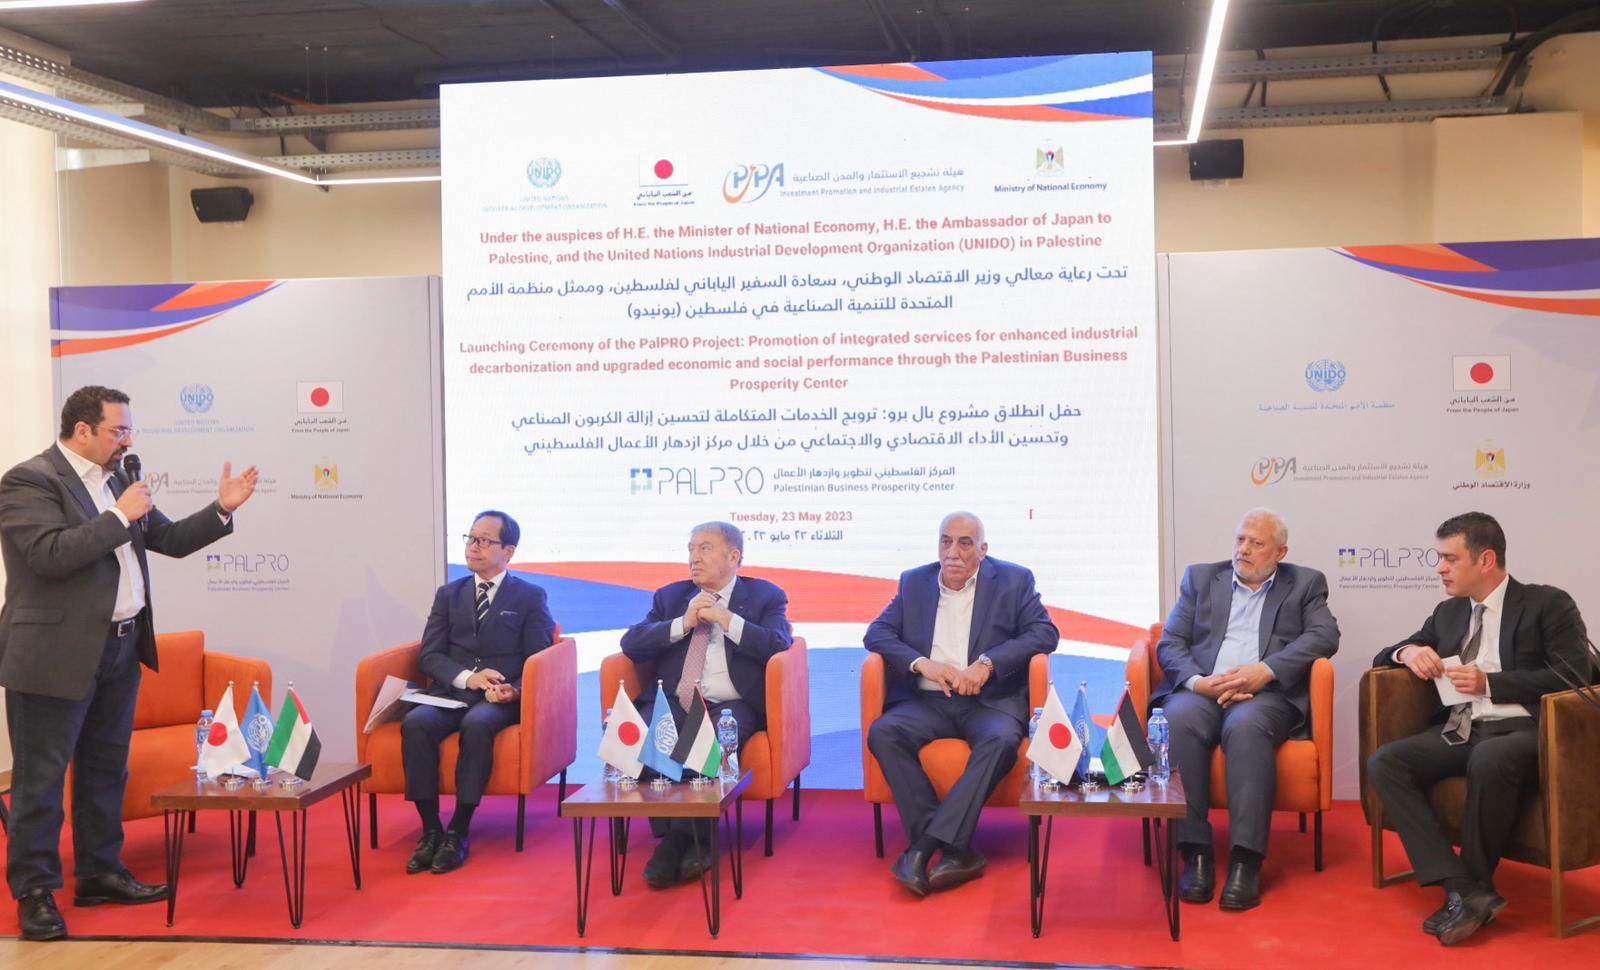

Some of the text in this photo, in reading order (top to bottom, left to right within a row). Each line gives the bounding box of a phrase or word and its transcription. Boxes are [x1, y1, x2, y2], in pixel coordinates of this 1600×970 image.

[993, 181, 1108, 195] Ministry of National Economy
[479, 212, 1112, 244] Under the auspices of H.E. the Minister of National Economy, H.E. the Ambassador of Japan to
[488, 234, 1103, 265] Palestine, and the United Nations Industrial Development Organization (UNIDO) in Palestine
[791, 273, 837, 288] سعادة
[906, 268, 970, 285] الاقتصاد
[974, 269, 1001, 286] وزير
[1004, 266, 1054, 288] معالي
[1055, 265, 1092, 284] رعاية
[1096, 265, 1129, 280] تحت
[466, 281, 504, 302] الأمم
[506, 281, 554, 296] منظمة
[556, 279, 605, 297] وممثل
[683, 275, 736, 297] الياباني
[740, 273, 787, 292] السفير
[684, 300, 748, 320] فلسطين
[751, 300, 780, 319] في
[783, 297, 843, 316] الصناعية
[847, 296, 897, 315] للتنمية
[900, 294, 954, 310] المتحدة
[459, 325, 1139, 355] Launching Ceremony of the PalPRO Project: Promotion of integrated services for enhanced industrial
[469, 349, 1128, 375] decarbonization and upgraded economic and social performance through the Palestinian Business
[1304, 368, 1347, 381] UNIDO
[729, 376, 849, 393] Prosperity Center
[180, 392, 215, 404] UNIDO
[511, 411, 571, 432] الصناعي
[574, 410, 623, 429] الكربون
[657, 408, 711, 427] لتحسين
[714, 407, 777, 423] المتكاملة
[780, 406, 838, 425] الخدمات
[841, 407, 878, 427] ترويج
[911, 405, 934, 424] بال
[938, 403, 990, 425] مشروع
[993, 403, 1045, 424] انطلاق
[1048, 403, 1083, 422] حفل
[523, 429, 1069, 457] وتحسين الأداء الاقتصادي والاجتماعي من خلال مركز ازدهار الأعمال الفلسطيني
[658, 466, 765, 496] PALPRO
[773, 466, 956, 481] المركز الفلسطيني لتطوير وازدهار الأعمال
[773, 482, 955, 495] Palestinian Business Prosperity Center
[730, 510, 853, 526] Tuesday, 23 May 2023
[769, 530, 791, 544] مايو
[223, 553, 290, 573] PALPRO
[1359, 547, 1441, 568] PALPRO
